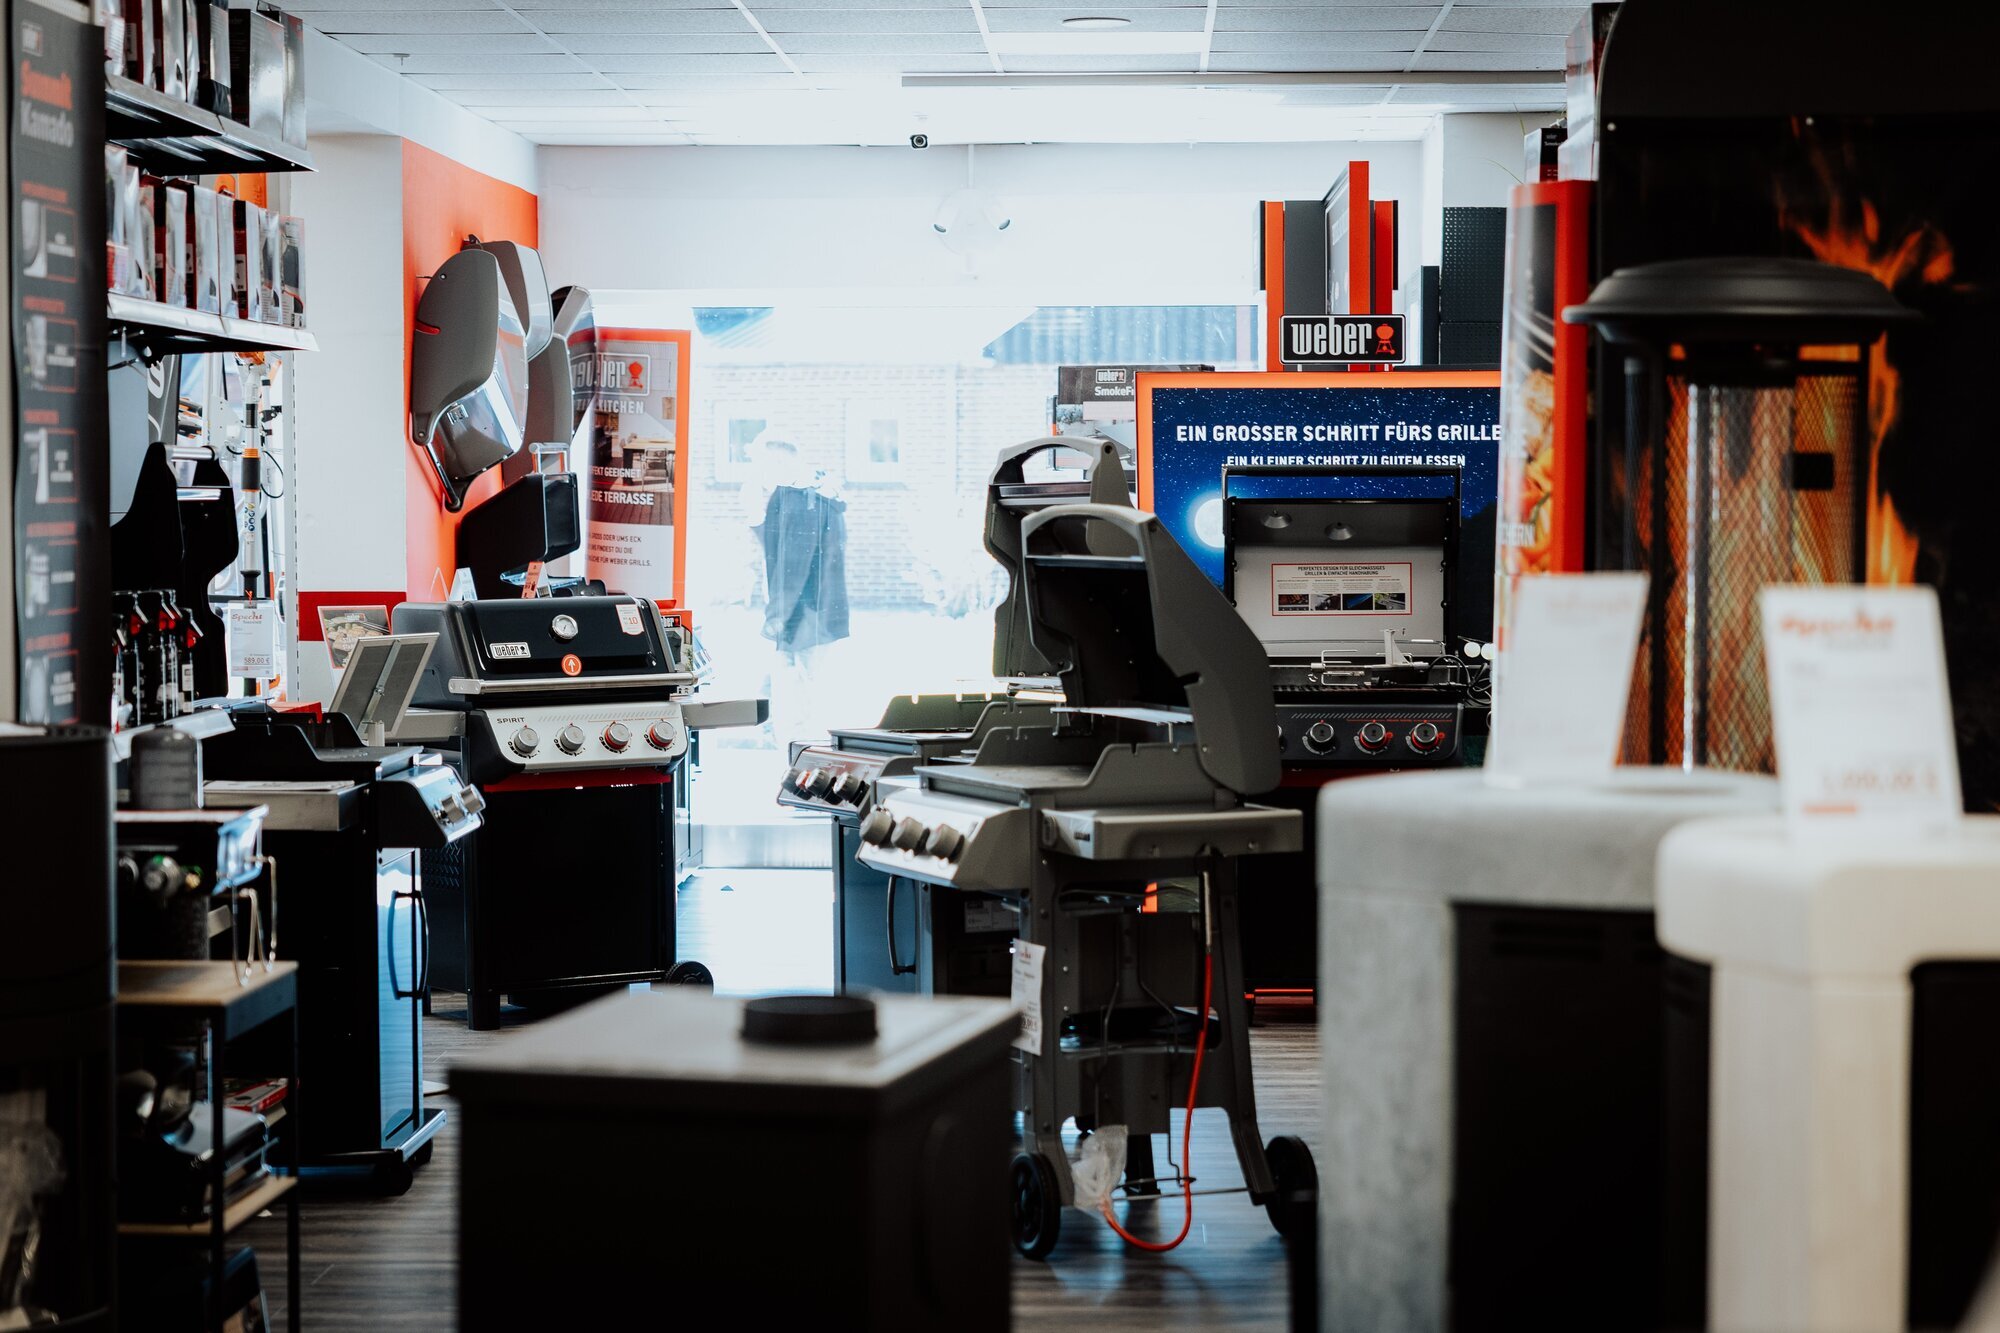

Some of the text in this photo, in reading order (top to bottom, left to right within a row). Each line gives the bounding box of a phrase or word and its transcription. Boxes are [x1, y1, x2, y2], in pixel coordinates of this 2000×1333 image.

[1291, 316, 1372, 356] weber
[598, 352, 626, 388] ber
[1176, 425, 1207, 442] EIN
[1212, 425, 1298, 442] GROSSER
[1303, 425, 1380, 442] SCHRITT
[1385, 421, 1433, 442] FÜRS
[1227, 455, 1248, 466] EIN
[1251, 455, 1304, 466] KLEINER
[1307, 455, 1359, 466] SCHRITT
[1426, 455, 1466, 466] ESSEN
[604, 467, 642, 478] GEEIGNET
[604, 491, 655, 506] TERRASSE
[628, 616, 639, 625] 10
[494, 644, 520, 657] weber
[496, 716, 526, 724] SPIRIT
